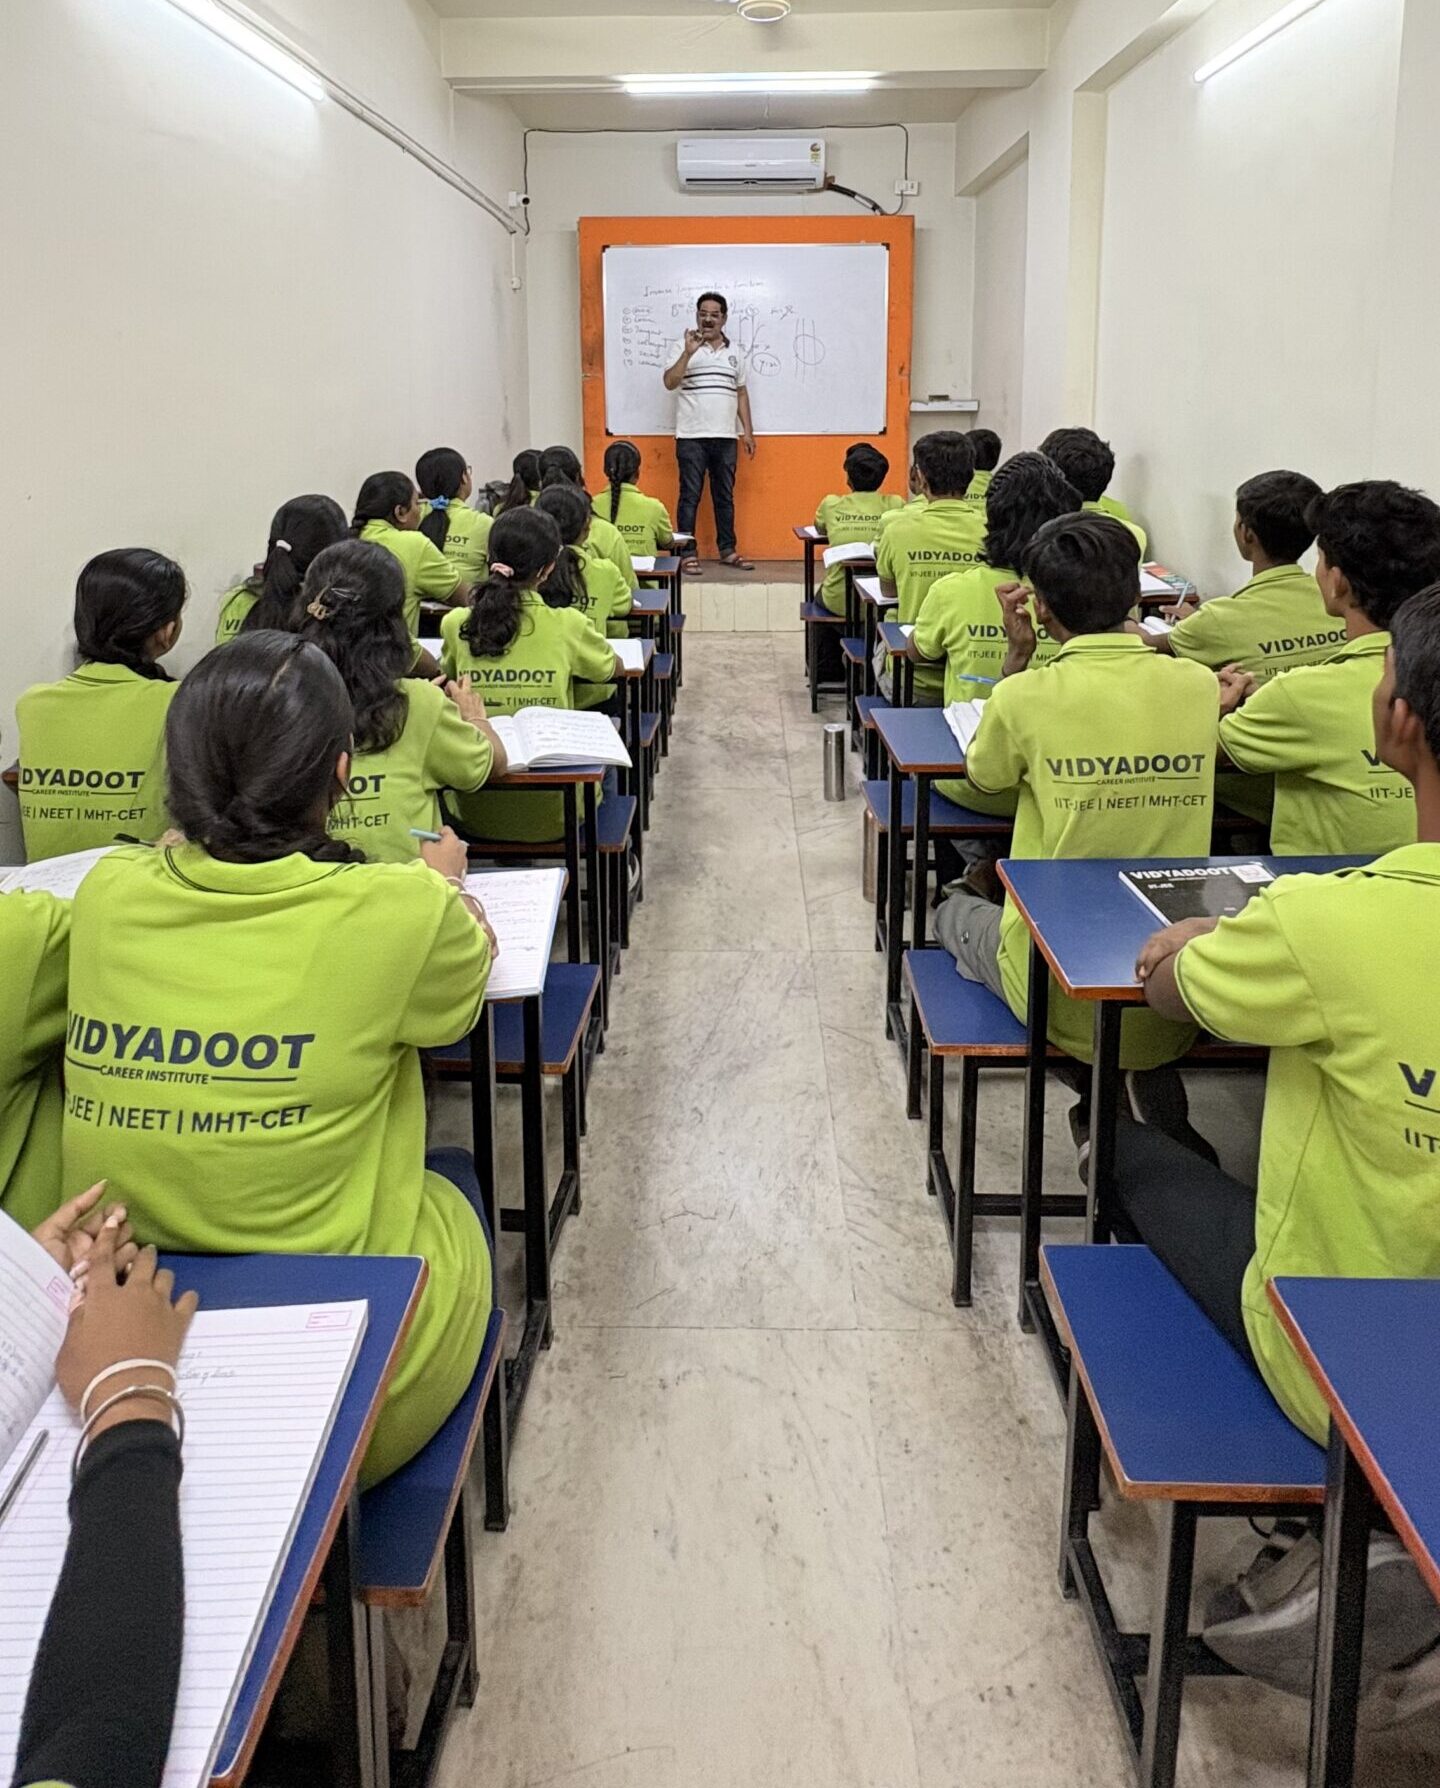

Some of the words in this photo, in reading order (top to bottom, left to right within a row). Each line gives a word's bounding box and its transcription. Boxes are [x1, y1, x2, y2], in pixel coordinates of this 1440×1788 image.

[1046, 754, 1205, 777] VIDYADOOT
[22, 768, 146, 789] DYADOOT
[1055, 797, 1094, 811] IIT-JEE
[1106, 796, 1139, 809] NEET
[1149, 794, 1207, 806] MHT-CET
[40, 807, 74, 819] NEET
[84, 807, 147, 821] MHT-CET
[1129, 867, 1230, 880] VIDYADOOT
[68, 1010, 316, 1070] VIDYADOOT
[100, 1065, 143, 1080] CAREER
[146, 1070, 209, 1085] INSTITUTE
[109, 1105, 171, 1131] NEET
[192, 1104, 312, 1133] MHT-CET
[1405, 1128, 1440, 1153] IIT
